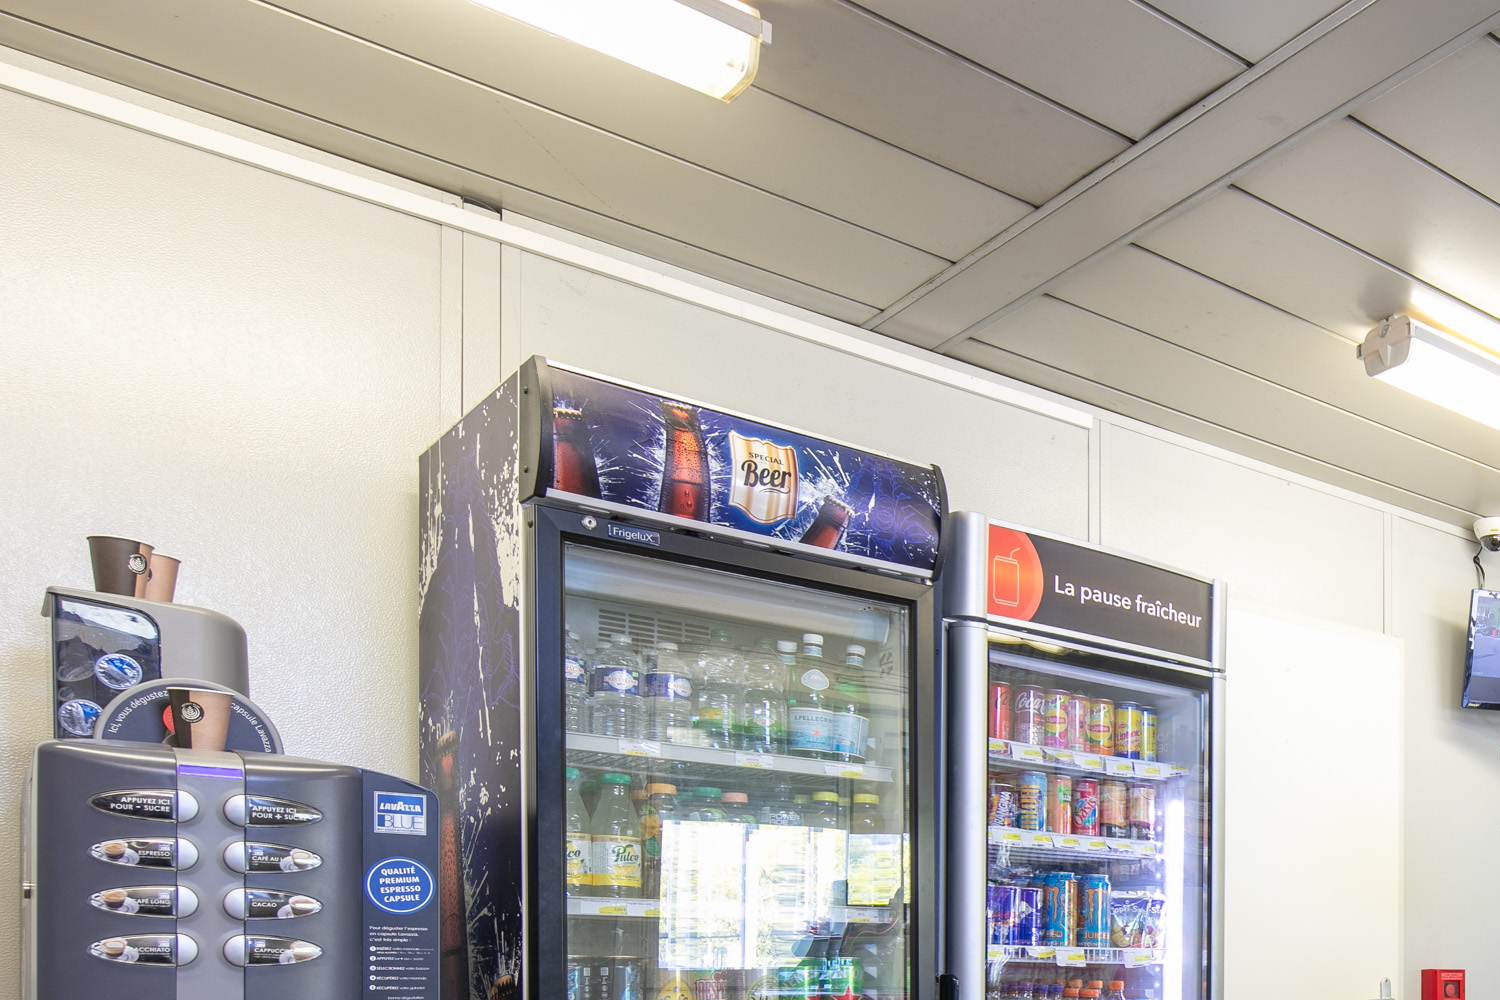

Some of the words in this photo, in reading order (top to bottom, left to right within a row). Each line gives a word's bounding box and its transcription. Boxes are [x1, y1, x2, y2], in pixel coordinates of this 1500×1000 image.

[748, 451, 785, 466] SPECIAL
[741, 460, 791, 490] Beer
[1054, 574, 1075, 597] La
[1080, 585, 1132, 610] pause
[1135, 594, 1202, 629] fraîcheur
[115, 706, 133, 724] vous
[131, 690, 169, 711] dégustez
[231, 702, 258, 727] capsule
[255, 724, 272, 753] Lavazza
[121, 796, 157, 805] APPUYEZ
[379, 801, 422, 812] LAVAZZA
[380, 813, 424, 830] BLUE
[612, 846, 639, 863] Pulco
[381, 866, 415, 875] QUALITÉ
[379, 875, 420, 884] PREMIUM
[380, 885, 421, 894] ESPRESSO
[384, 894, 420, 903] CAPSULE
